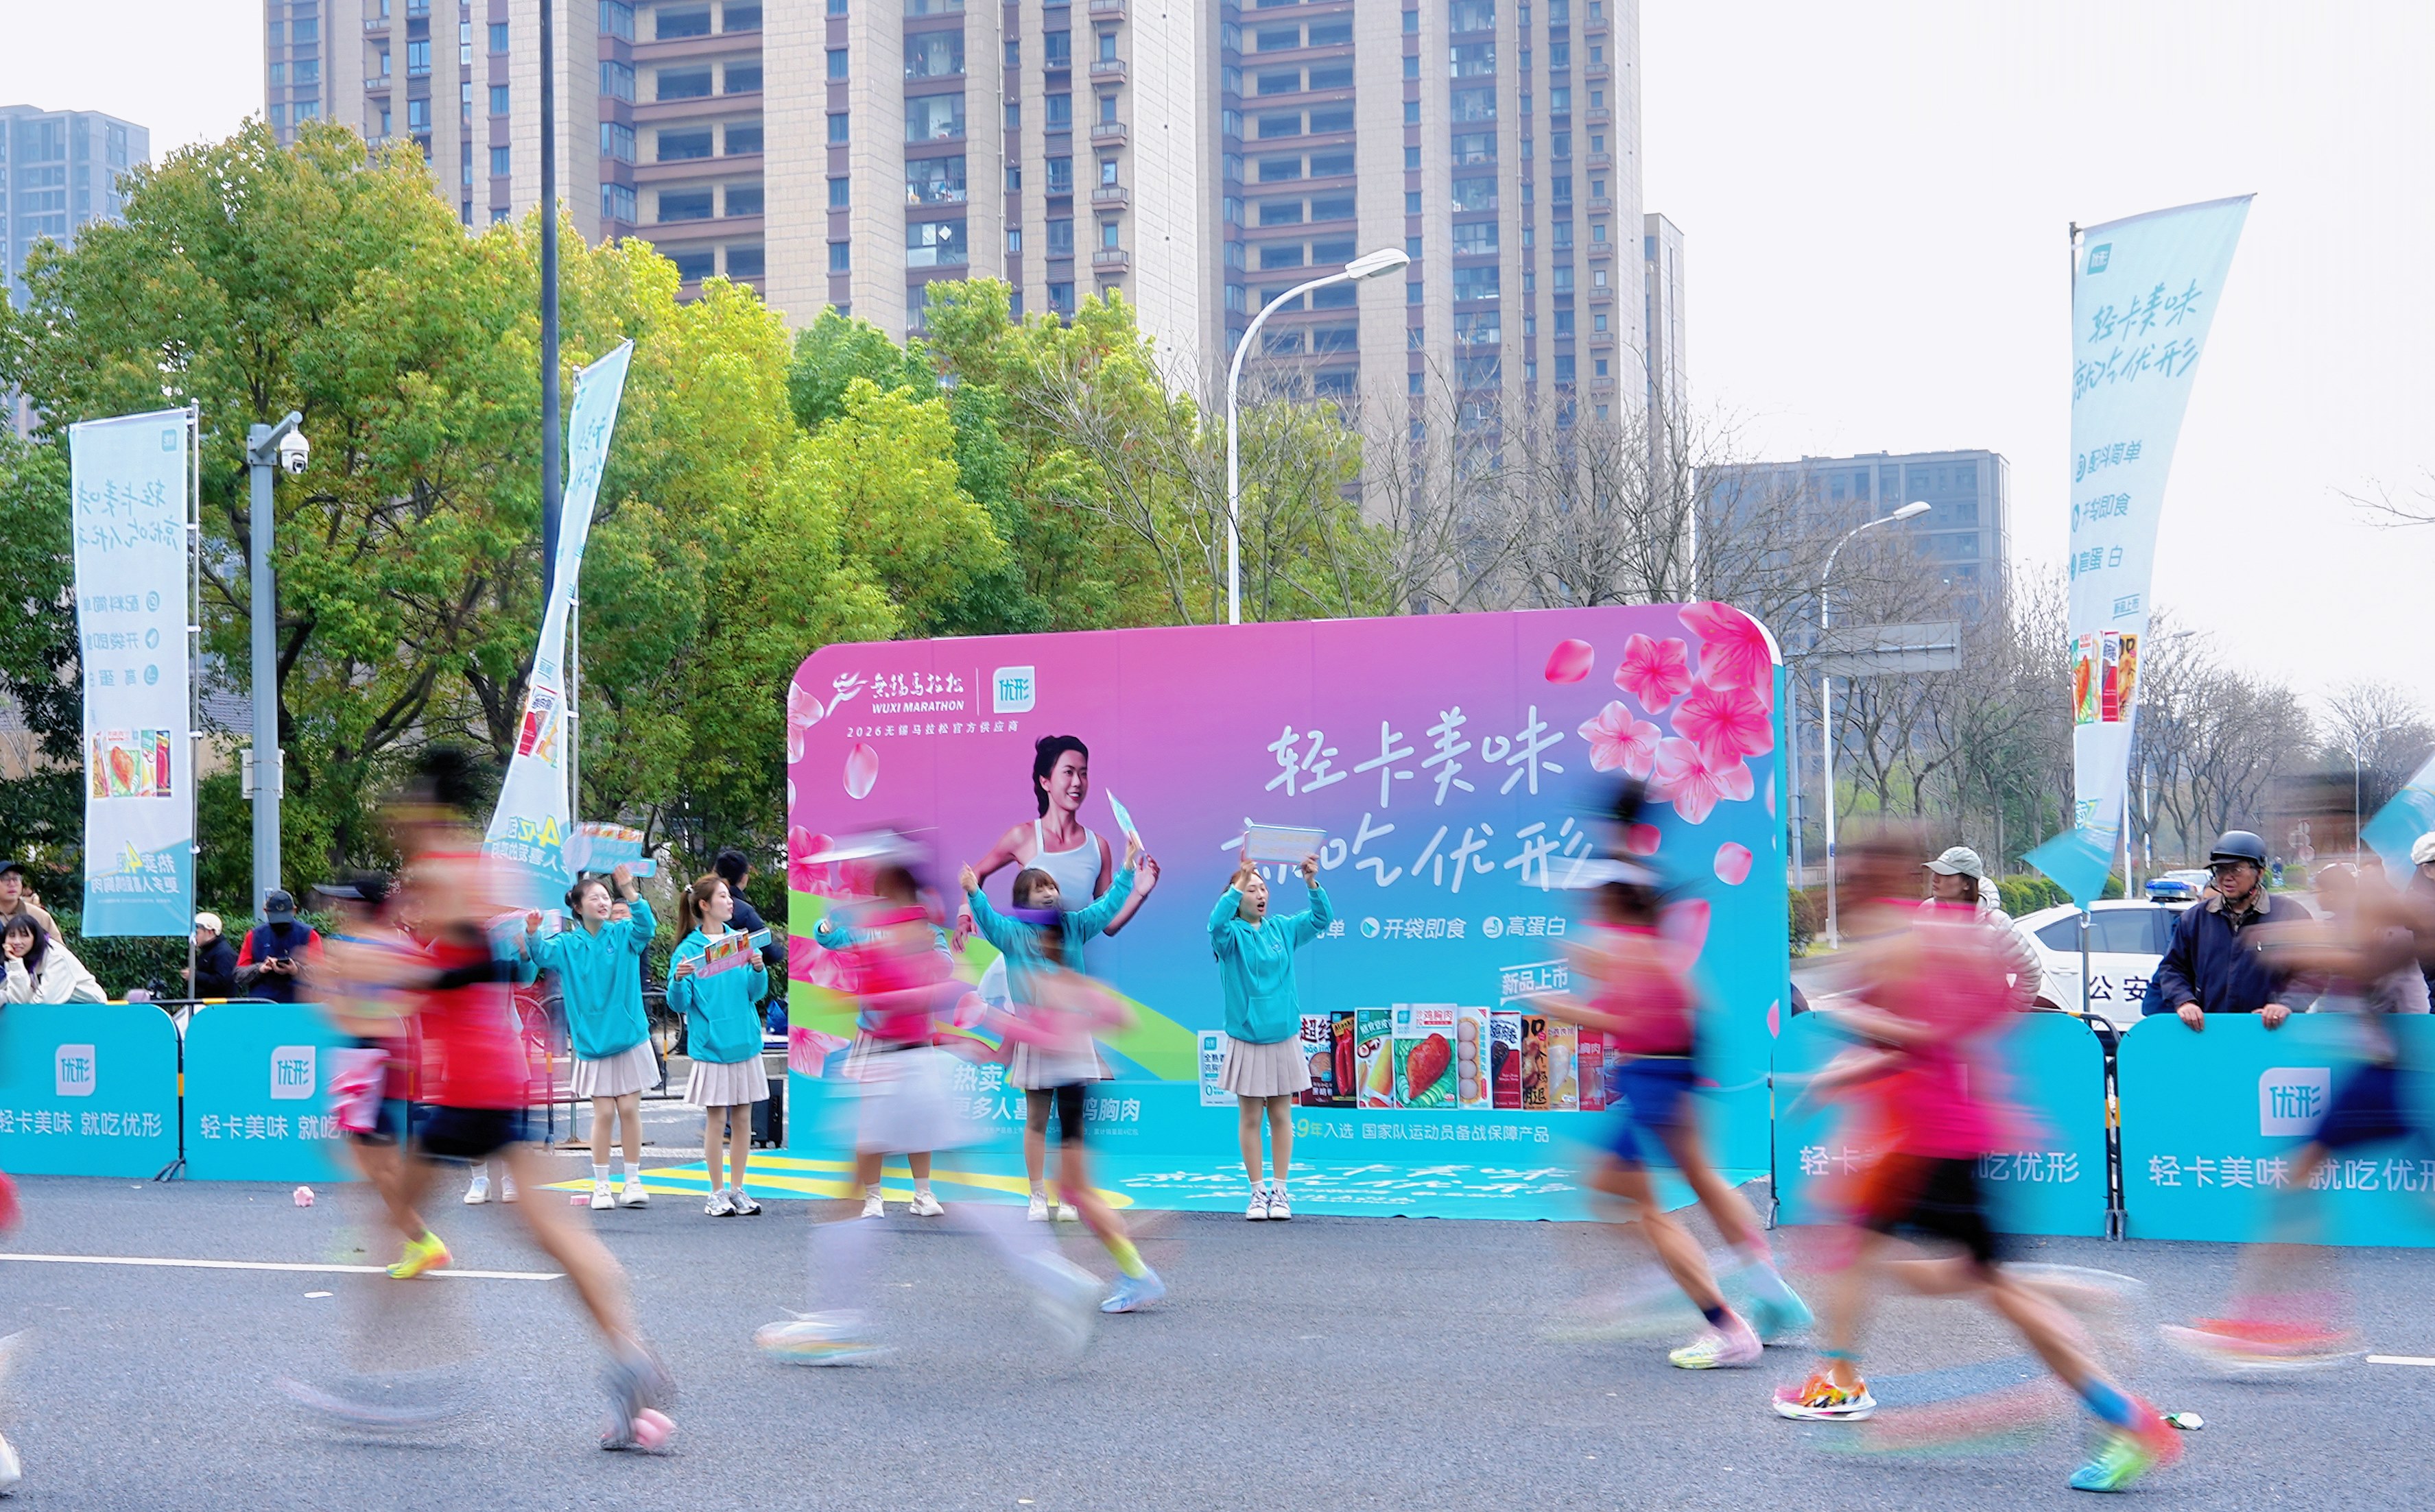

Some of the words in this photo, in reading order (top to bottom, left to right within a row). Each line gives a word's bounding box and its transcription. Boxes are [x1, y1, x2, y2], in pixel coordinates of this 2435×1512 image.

[2089, 278, 2202, 344] 轻卡美味
[999, 678, 1030, 701] 优形
[871, 703, 901, 714] WUXI
[903, 700, 964, 713] MARATHON
[1264, 704, 1565, 809] 轻卡美味
[1220, 813, 1594, 894] 吃优形
[1383, 917, 1466, 939] 开袋即食
[1506, 915, 1567, 937] 高蛋白
[1502, 965, 1569, 996] 新品上市
[2089, 975, 2150, 1002] 公安
[62, 1057, 89, 1082] 优形
[277, 1059, 309, 1085] 优形
[953, 1064, 1003, 1092] 热卖
[952, 1096, 1141, 1122] 更多人喜鸡胸肉
[2269, 1085, 2321, 1119] 优形
[0, 1109, 73, 1136] 轻卡美味
[80, 1112, 163, 1138] 就吃优形
[200, 1114, 289, 1140] 轻卡美味
[298, 1115, 353, 1140] 就吃
[1266, 1118, 1354, 1140] 9年入选
[1362, 1122, 1549, 1144] 国家队运动员备战保障产品
[1971, 1151, 2080, 1184] 吃优形
[2148, 1154, 2291, 1190] 轻卡美味
